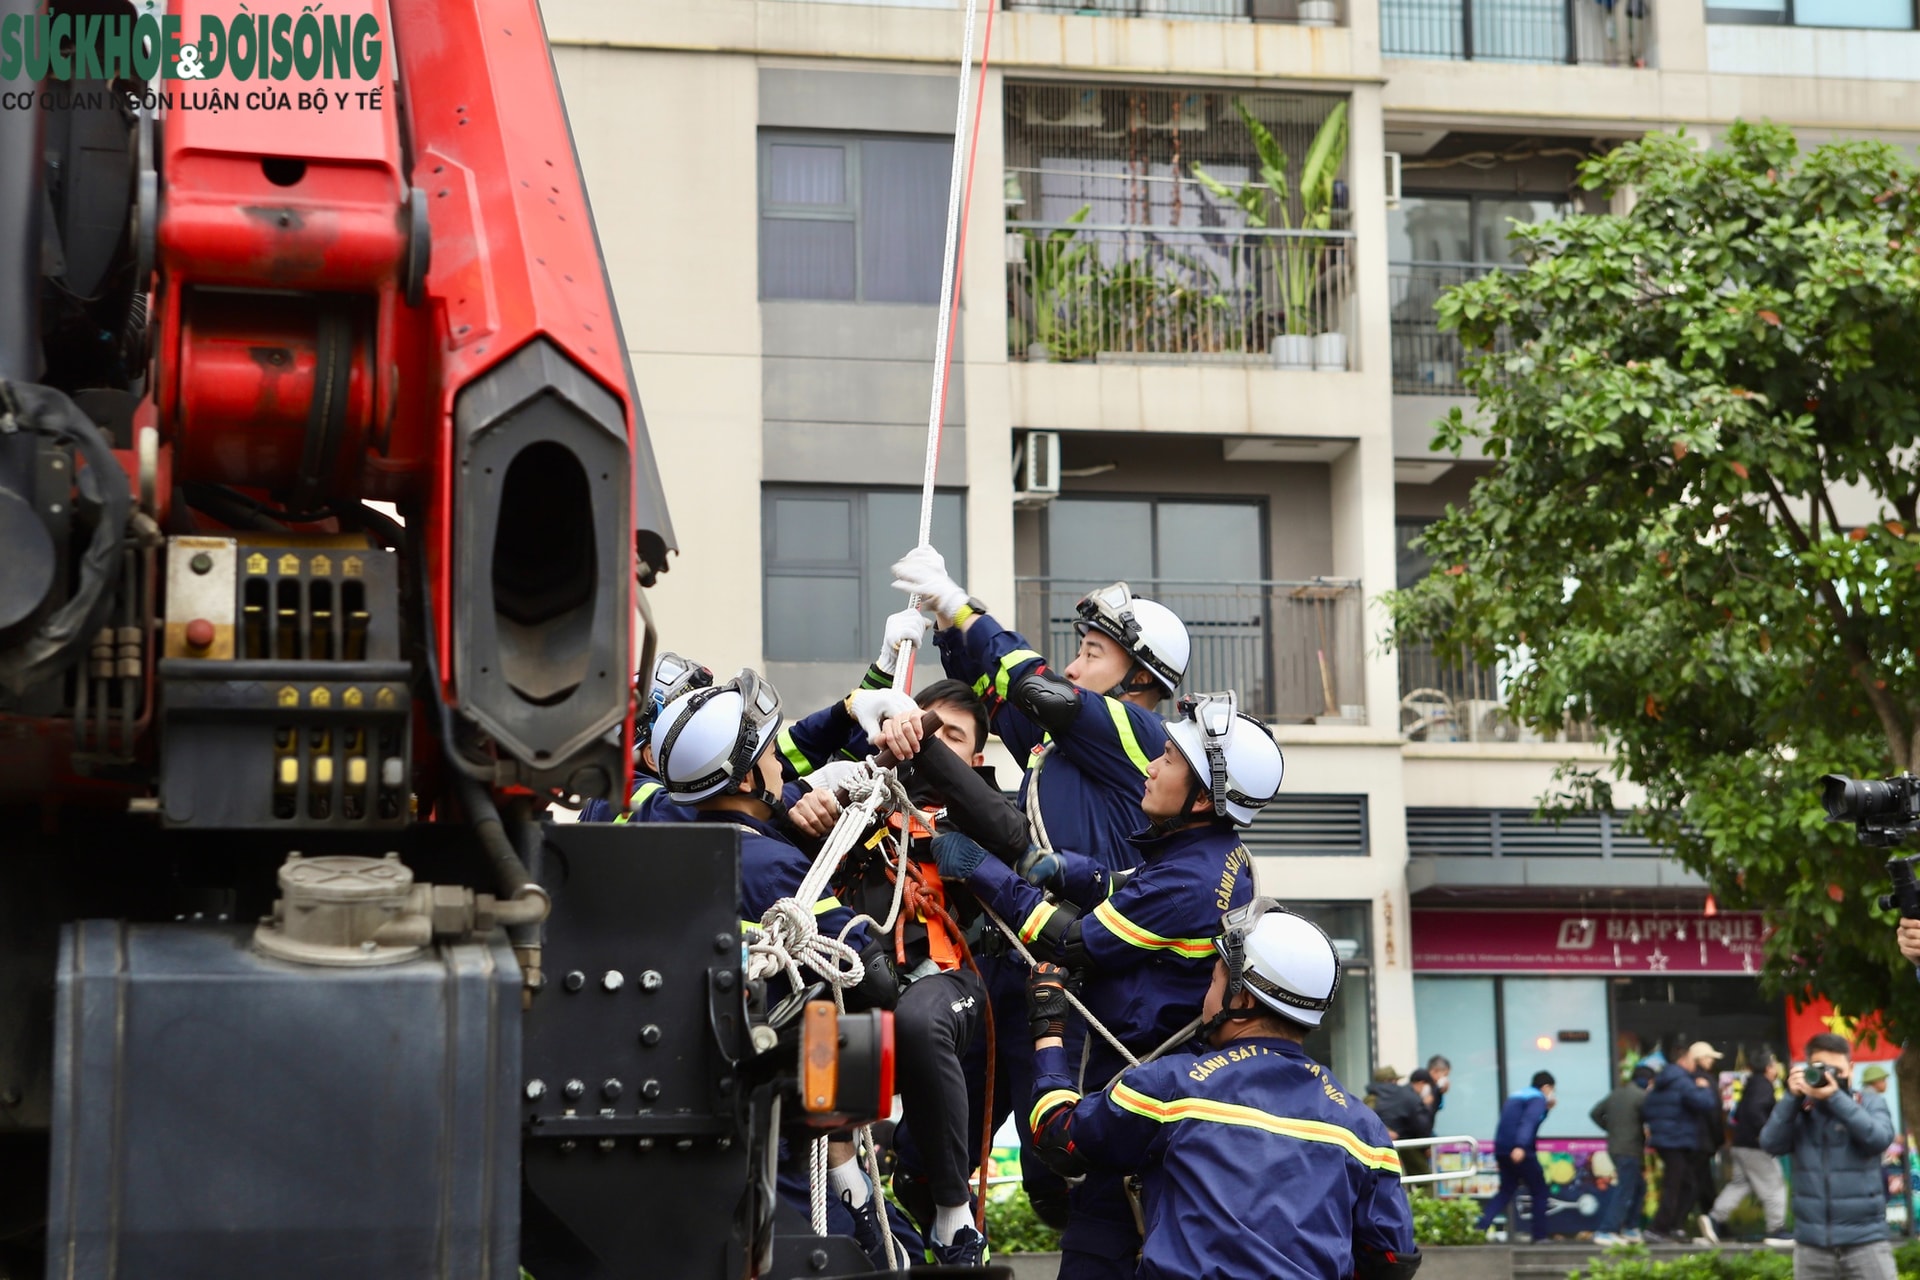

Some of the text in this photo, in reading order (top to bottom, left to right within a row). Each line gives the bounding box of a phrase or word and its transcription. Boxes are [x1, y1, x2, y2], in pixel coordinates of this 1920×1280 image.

[1606, 919, 1687, 940] HAPPY
[1278, 991, 1316, 1007] GENTOS
[1189, 1055, 1229, 1082] CẢNH
[1228, 1045, 1257, 1062] SÁT
